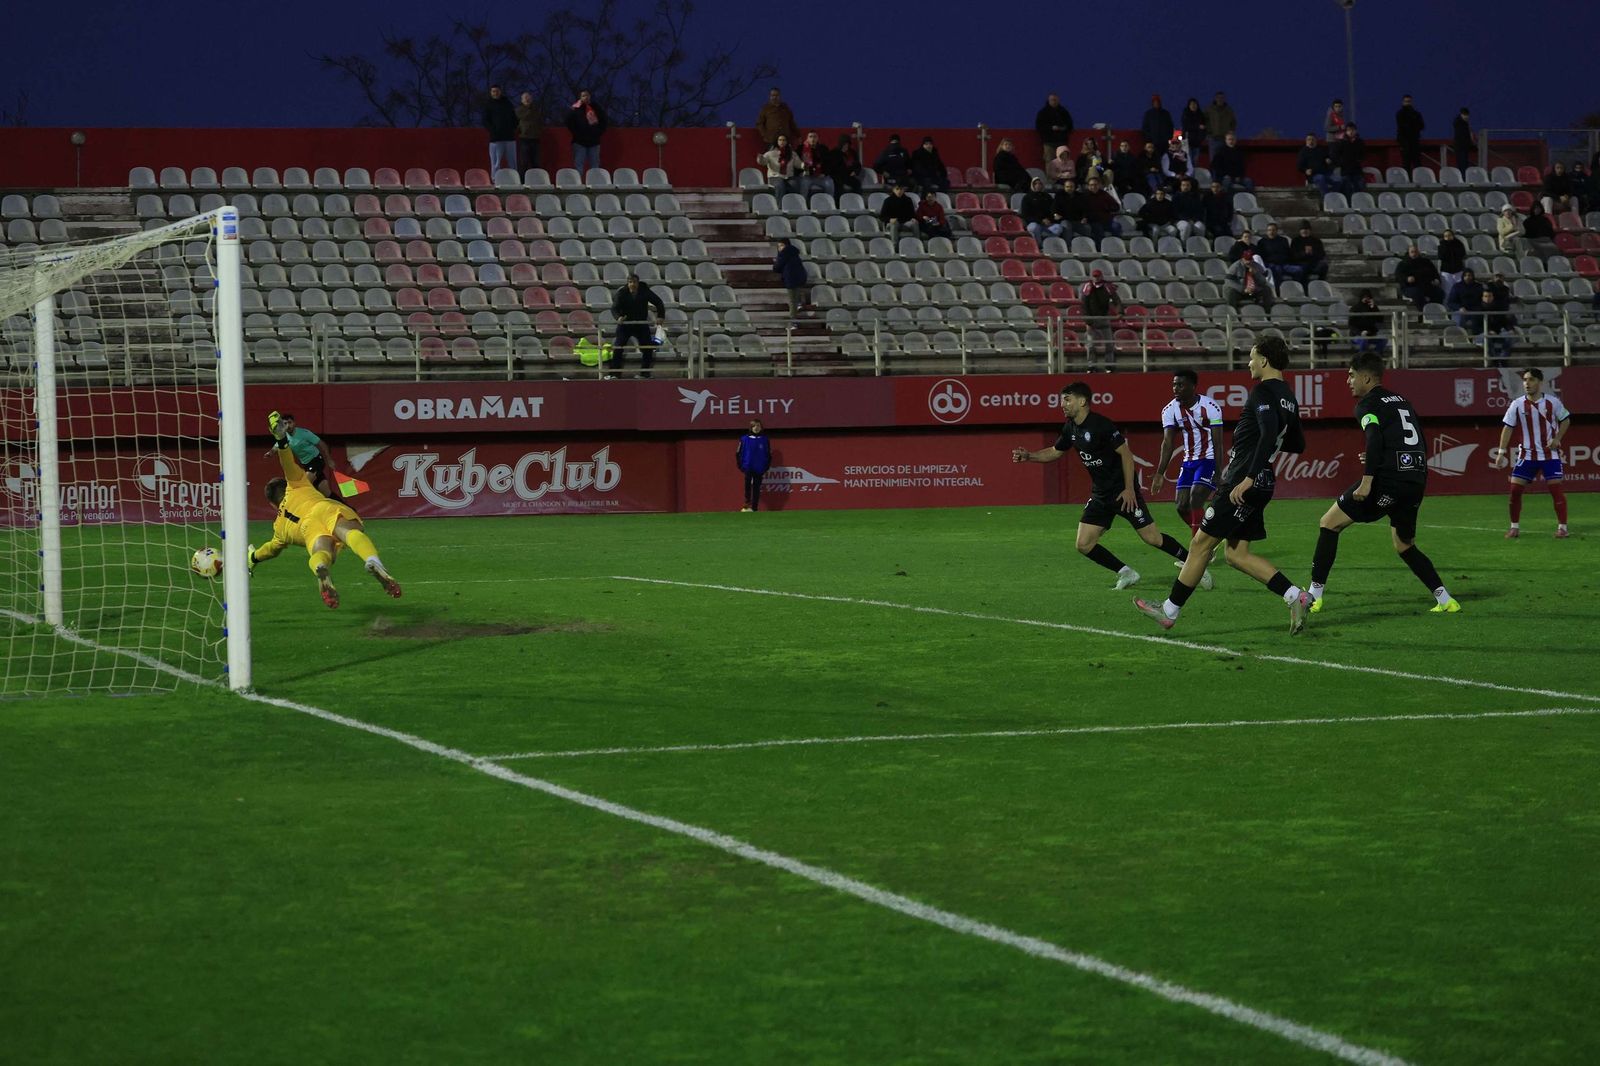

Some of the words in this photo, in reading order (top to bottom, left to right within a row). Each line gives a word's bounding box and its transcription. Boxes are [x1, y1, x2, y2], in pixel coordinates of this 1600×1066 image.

[394, 395, 545, 420] OBRAMAT
[710, 395, 794, 414] HÉLITY
[980, 393, 1041, 407] centro
[1397, 408, 1419, 446] 5
[392, 444, 622, 509] KubeClub
[844, 465, 896, 475] SERVICIOS
[897, 465, 911, 474] DE
[913, 465, 959, 474] LIMPIEZA
[961, 464, 968, 473] Y
[844, 478, 931, 488] MANTENIMIENTO
[933, 477, 984, 487] INTEGRAL
[159, 509, 191, 519] Servicio
[192, 508, 203, 517] de
